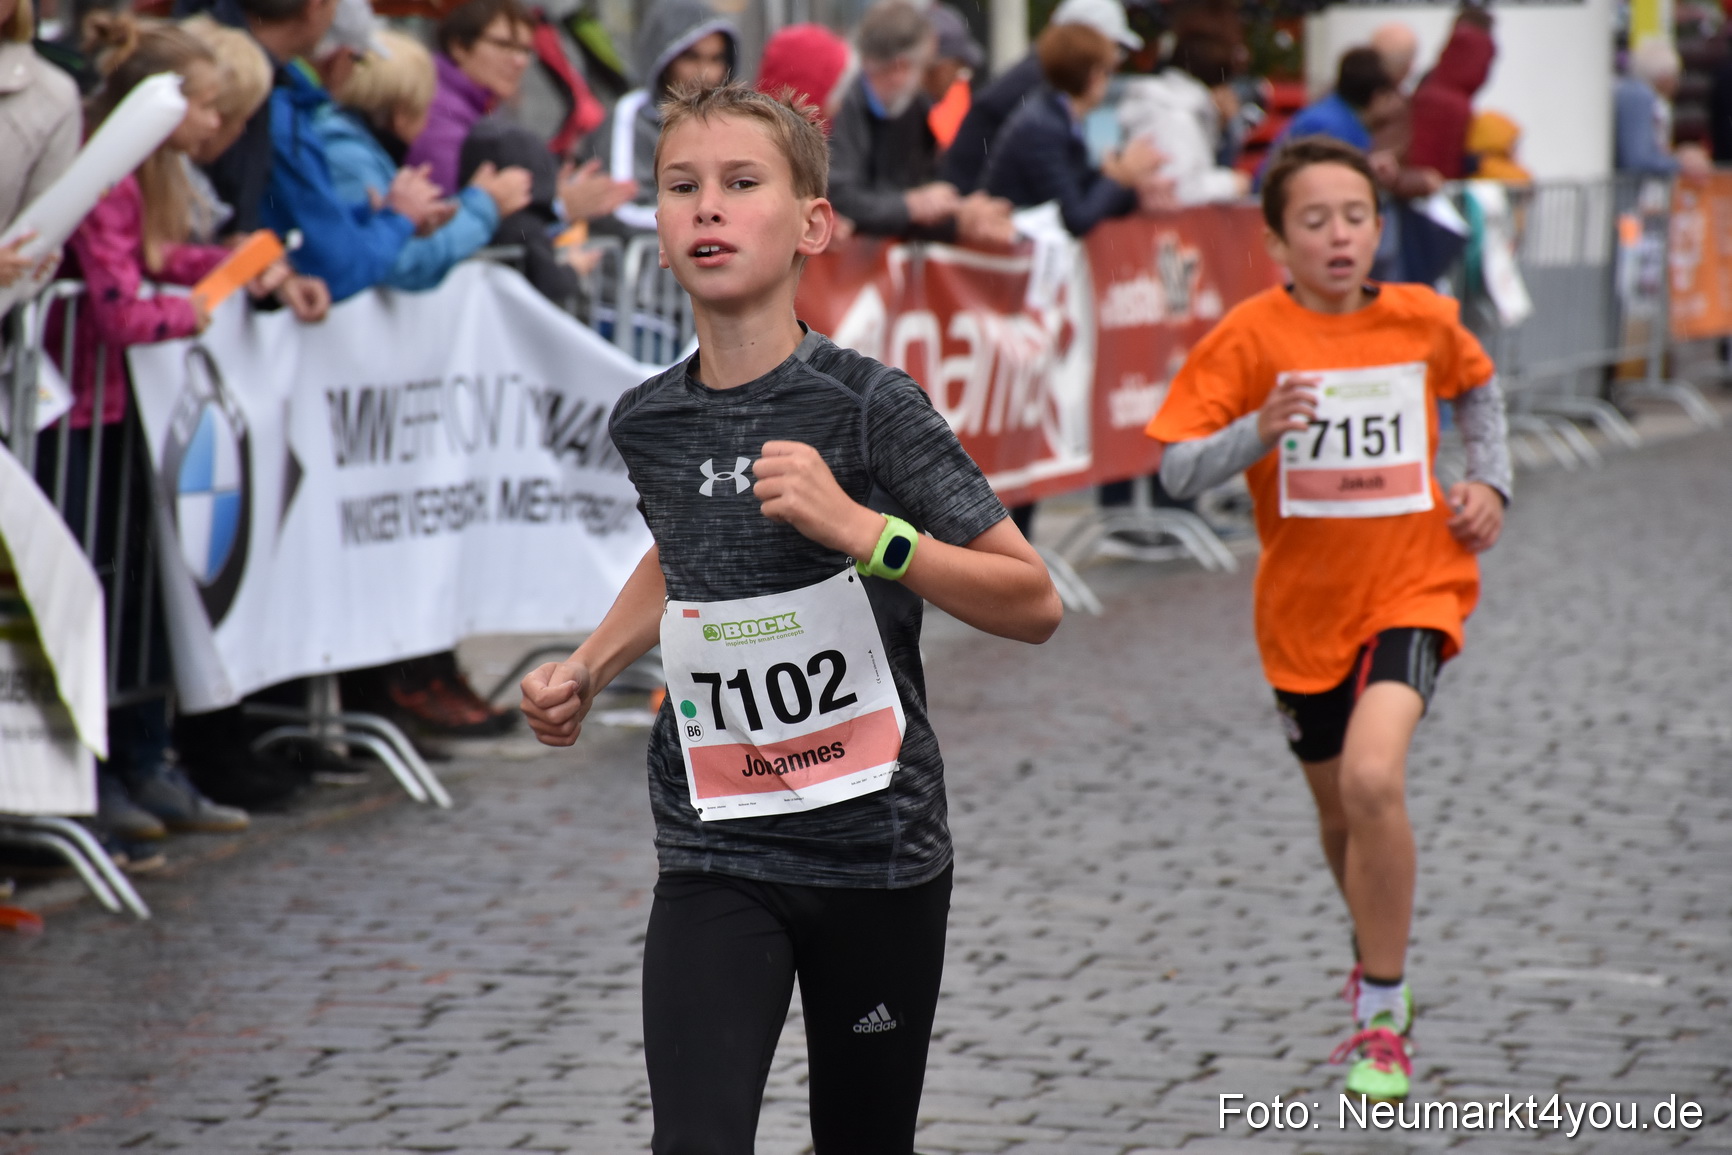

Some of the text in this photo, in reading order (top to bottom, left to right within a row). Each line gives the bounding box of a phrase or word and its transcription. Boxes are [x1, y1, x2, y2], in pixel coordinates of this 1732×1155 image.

[1307, 411, 1402, 459] 7151
[721, 611, 802, 640] BOCK
[725, 639, 749, 647] inspired
[757, 635, 776, 643] smart
[776, 629, 805, 640] concepts
[690, 649, 858, 732] 7102
[687, 725, 701, 737] B6
[741, 741, 846, 777] Johannes
[852, 1020, 897, 1033] adidas
